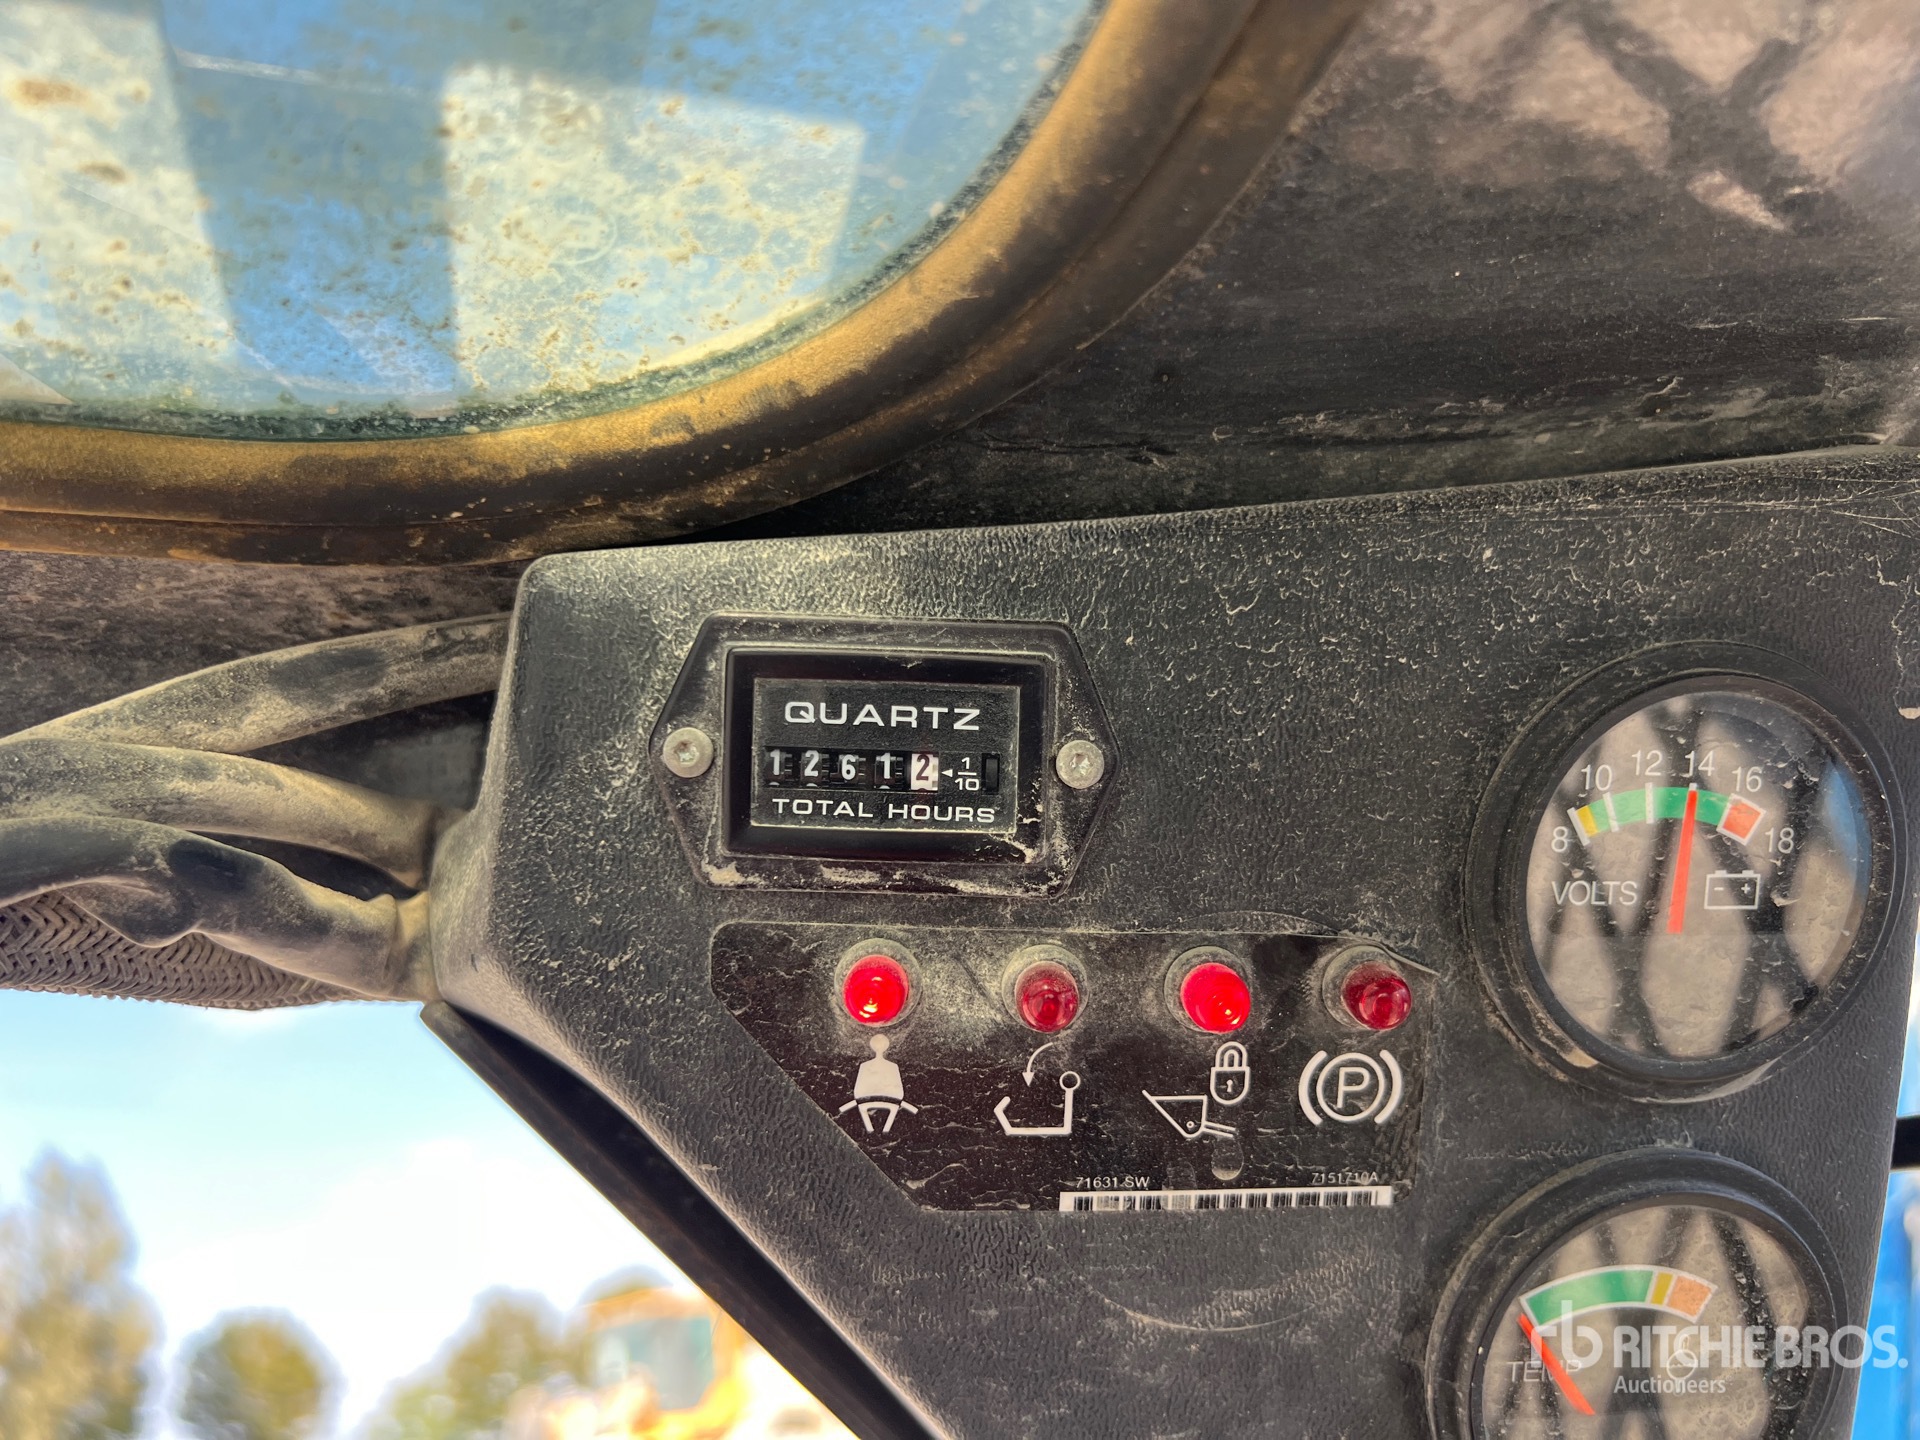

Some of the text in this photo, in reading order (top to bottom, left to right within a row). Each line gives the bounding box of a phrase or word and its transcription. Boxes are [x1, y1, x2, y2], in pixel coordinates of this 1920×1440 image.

[784, 701, 980, 731] QUARTZ
[1631, 750, 1663, 776] 12
[1684, 751, 1715, 777] 14
[1581, 765, 1612, 792] 10
[1731, 766, 1762, 792] 16
[772, 798, 995, 822] TOTAL HOURS
[1551, 826, 1568, 853] 8
[1765, 827, 1795, 854] 18
[1551, 880, 1638, 906] VOLTS
[1076, 1176, 1118, 1189] 71631
